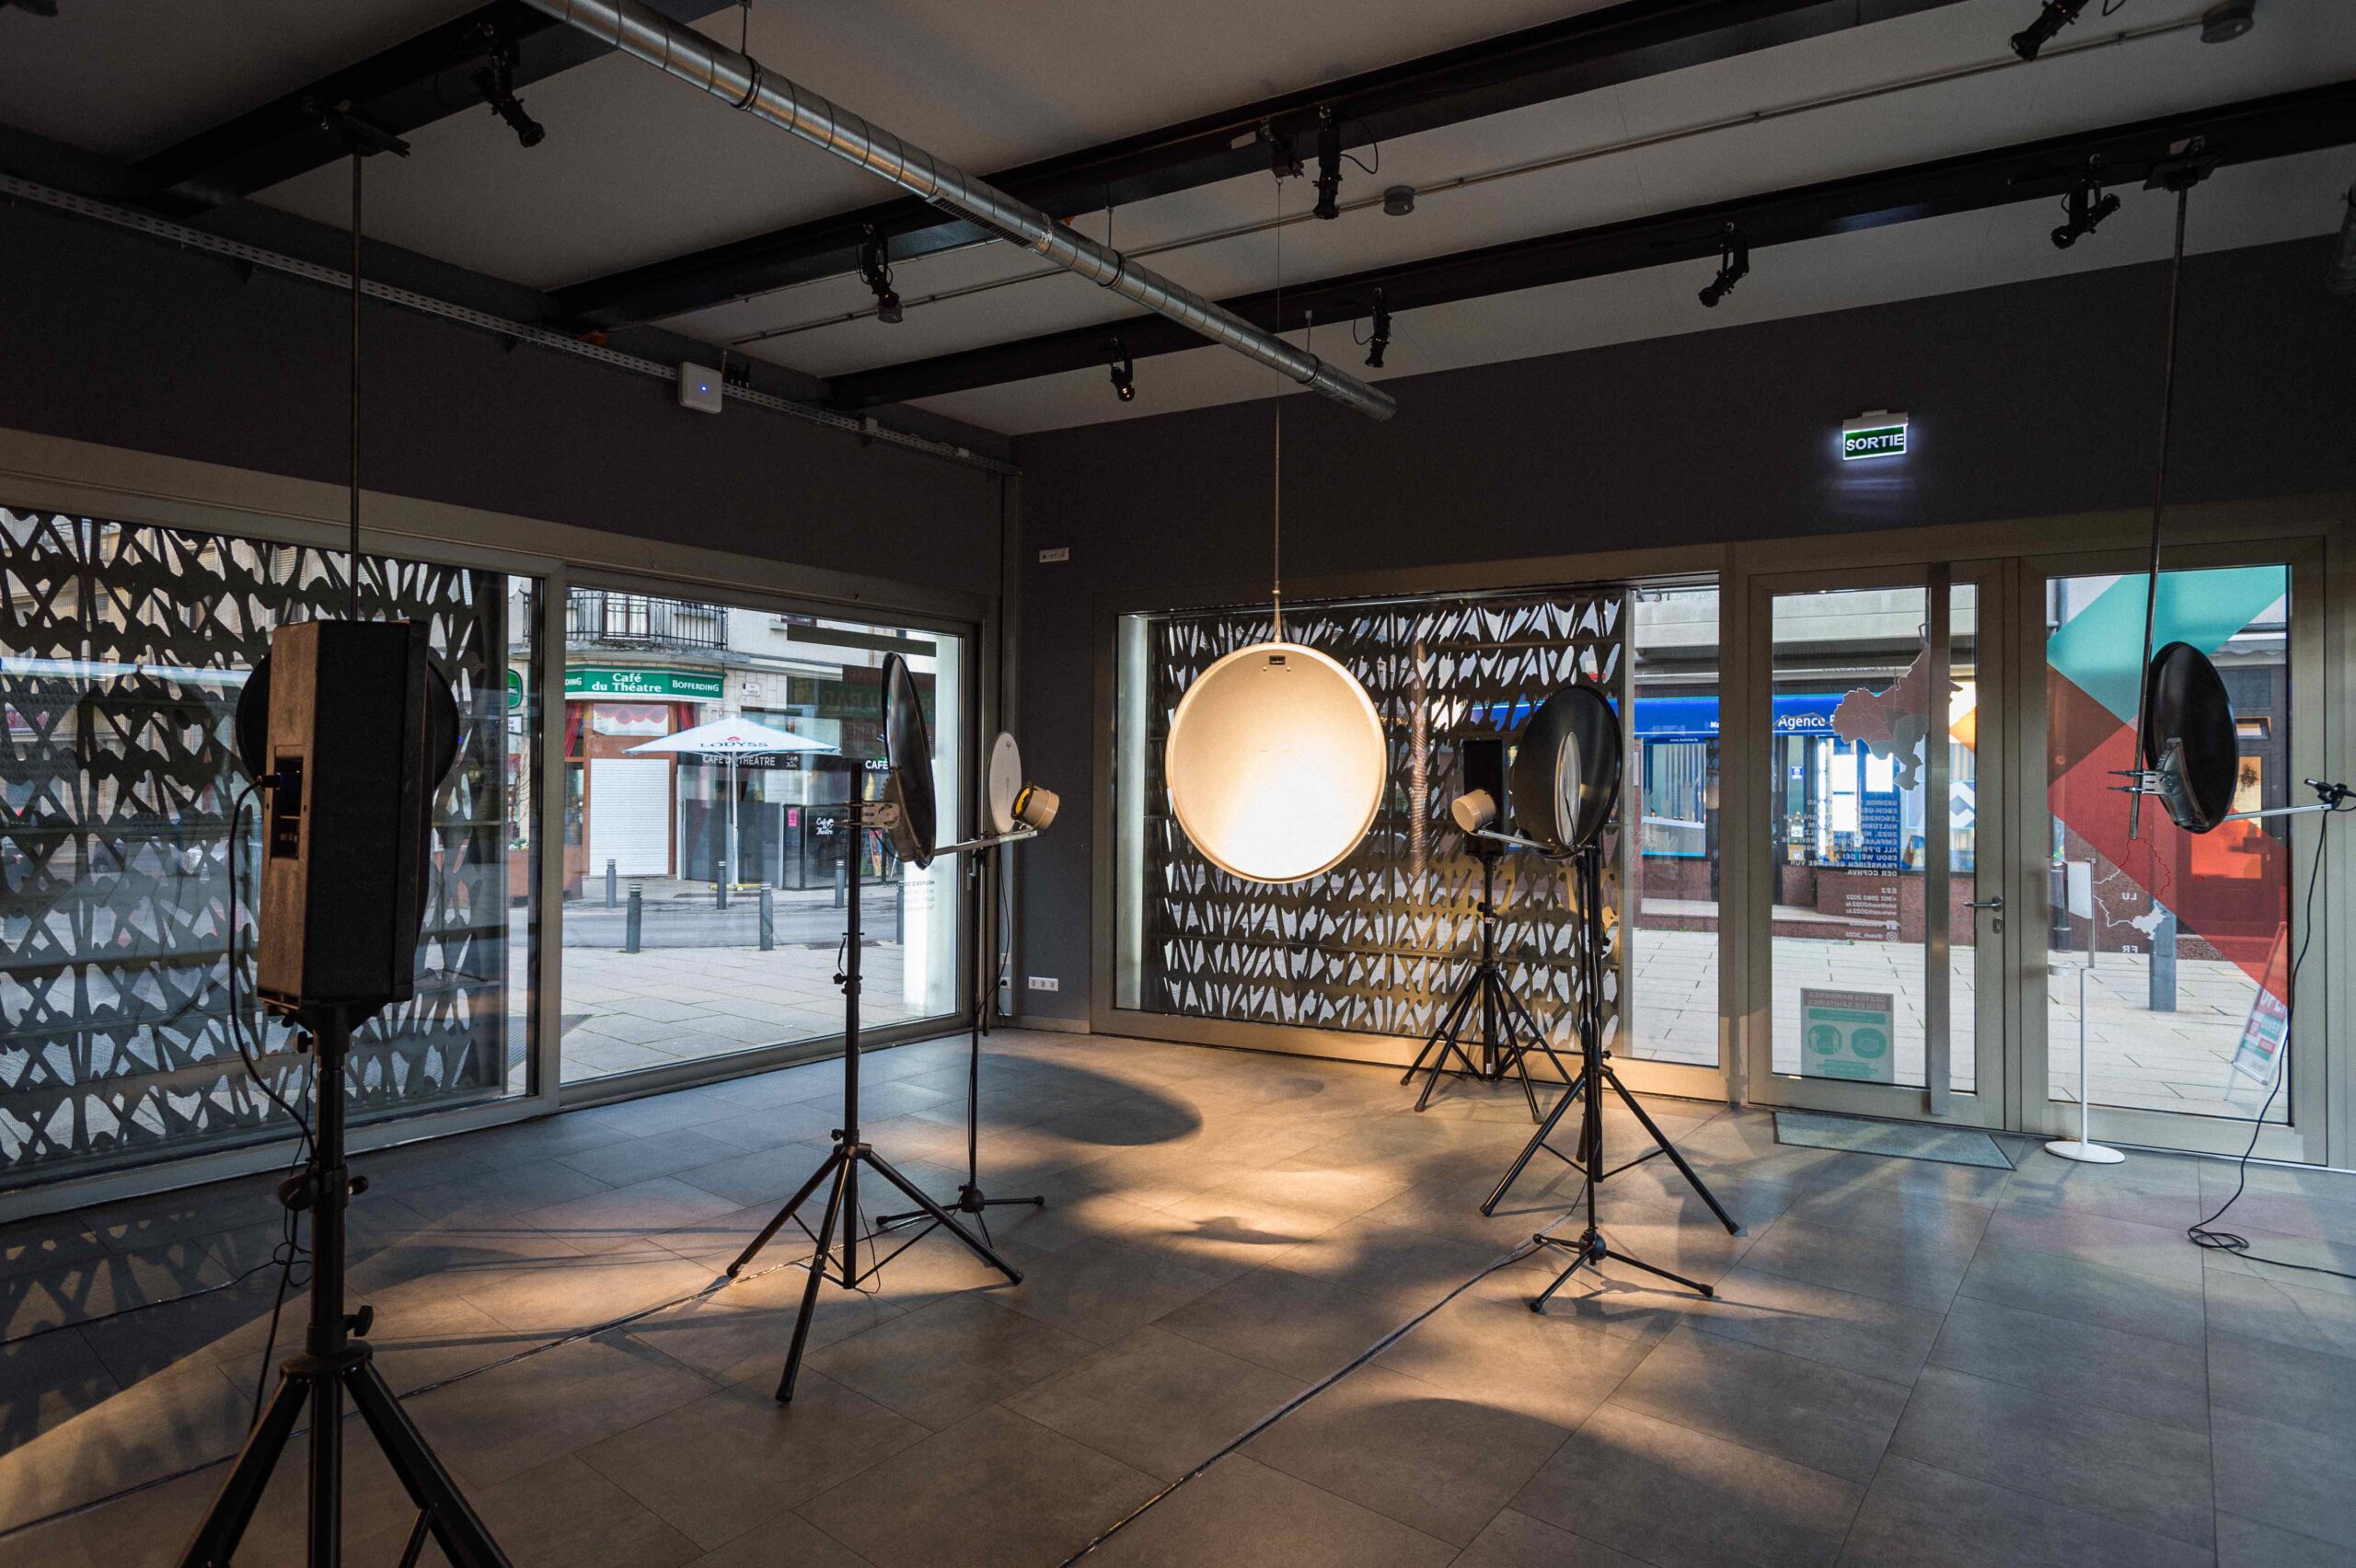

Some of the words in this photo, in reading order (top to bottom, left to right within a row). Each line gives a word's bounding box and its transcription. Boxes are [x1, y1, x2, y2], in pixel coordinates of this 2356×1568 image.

[1846, 433, 1904, 451] SORTIE
[612, 673, 642, 683] Café
[591, 681, 608, 691] du
[672, 679, 720, 692] BOFFERDING
[1778, 716, 1826, 730] Agence
